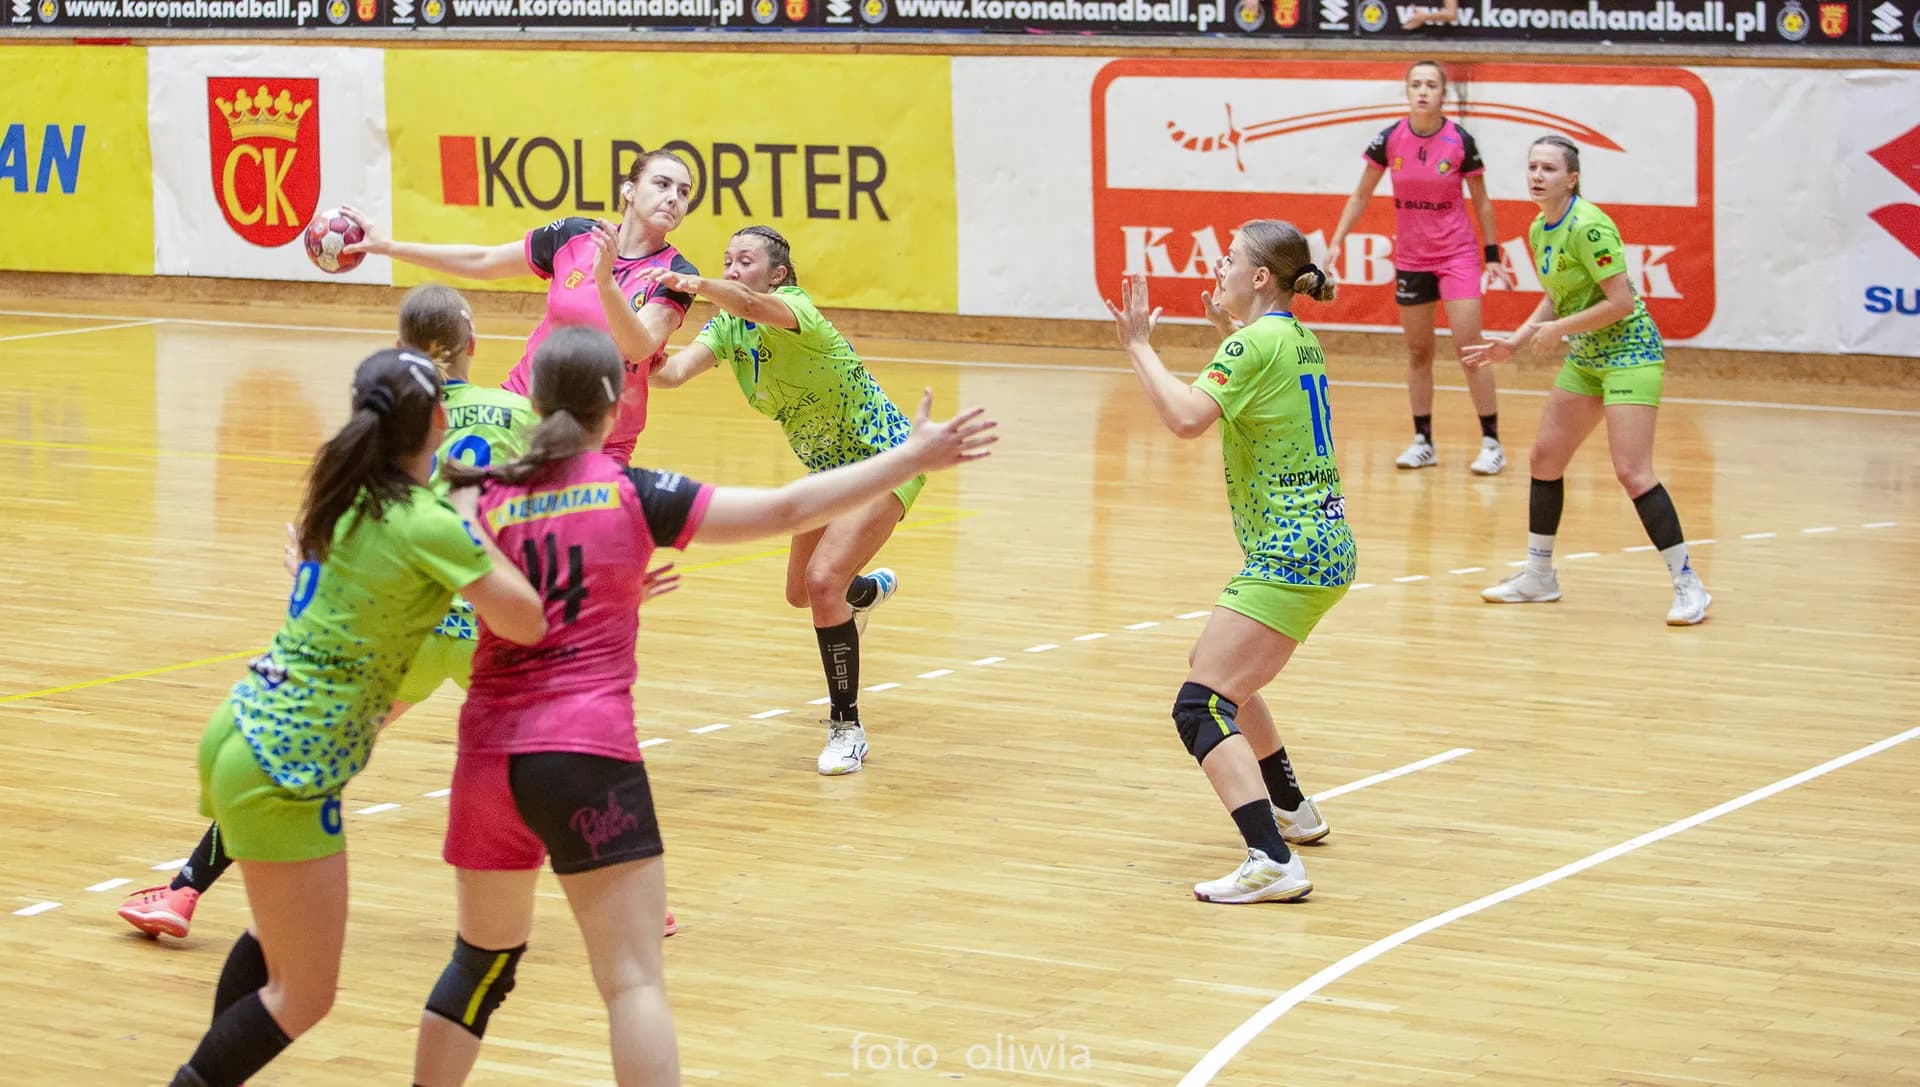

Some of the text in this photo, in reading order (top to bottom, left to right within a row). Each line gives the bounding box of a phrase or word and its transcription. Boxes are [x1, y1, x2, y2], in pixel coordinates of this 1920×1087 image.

[895, 0, 1226, 31] www.koronahandball.pl
[222, 143, 302, 227] CK
[1541, 245, 1552, 276] 3
[1864, 286, 1920, 315] SU
[1279, 472, 1306, 487] KPR
